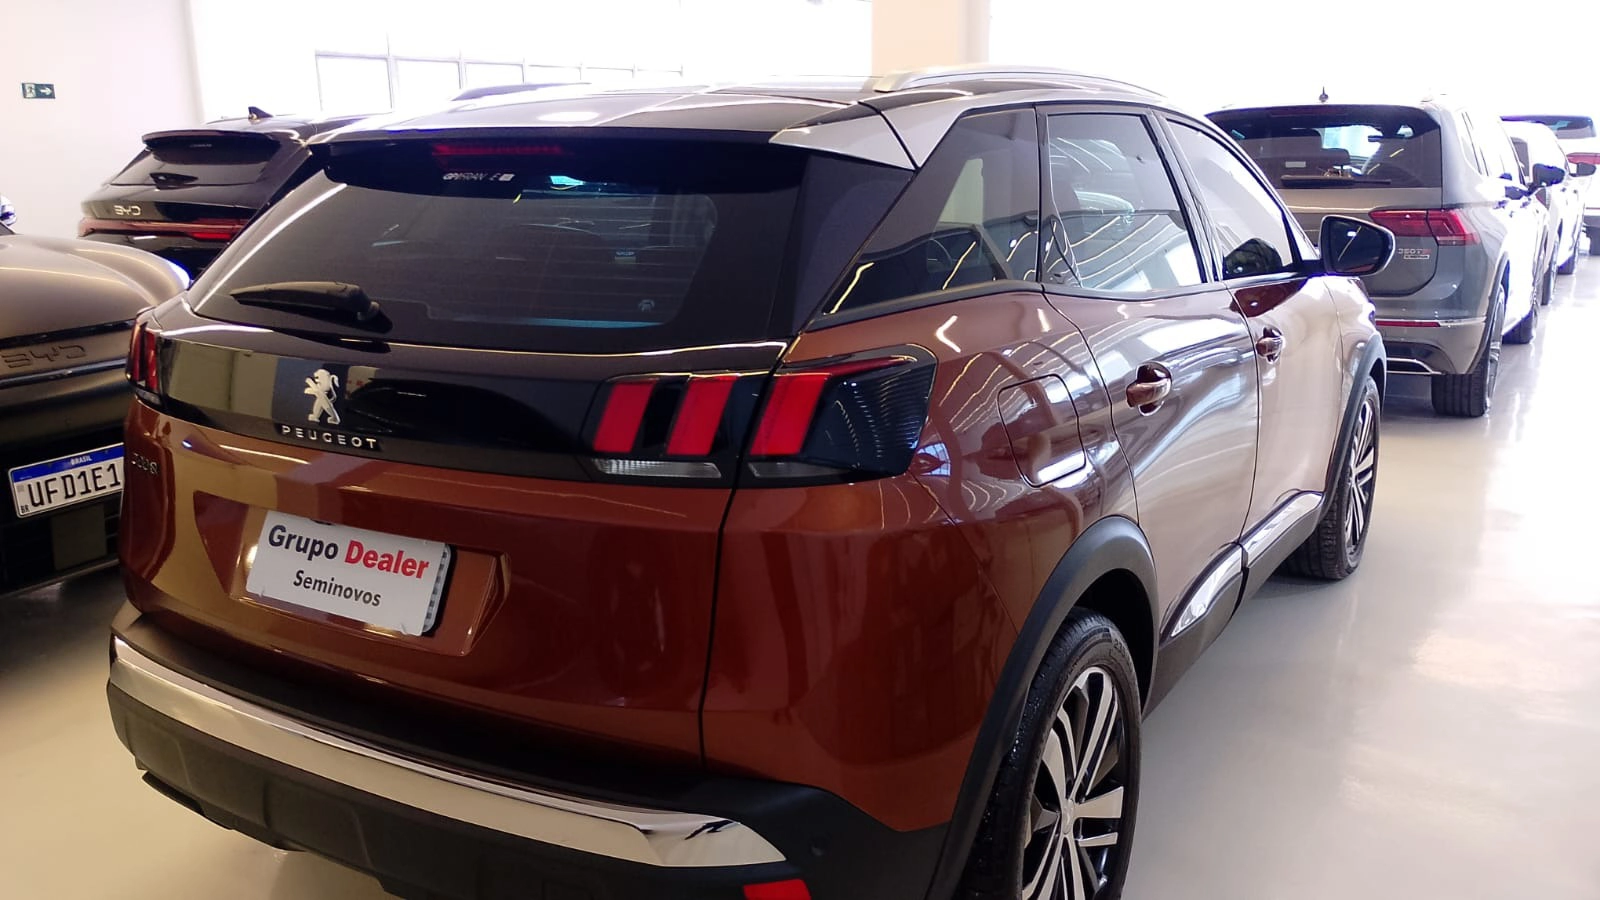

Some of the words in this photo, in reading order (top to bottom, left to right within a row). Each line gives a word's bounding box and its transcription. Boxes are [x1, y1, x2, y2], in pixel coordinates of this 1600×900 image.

[113, 204, 141, 216] BYD
[281, 425, 377, 449] PEUGEOT
[70, 455, 92, 466] BRASIL
[27, 463, 121, 508] UFD1E1
[268, 524, 339, 562] Grupo
[344, 540, 430, 579] Dealer
[293, 569, 382, 607] Seminovos
